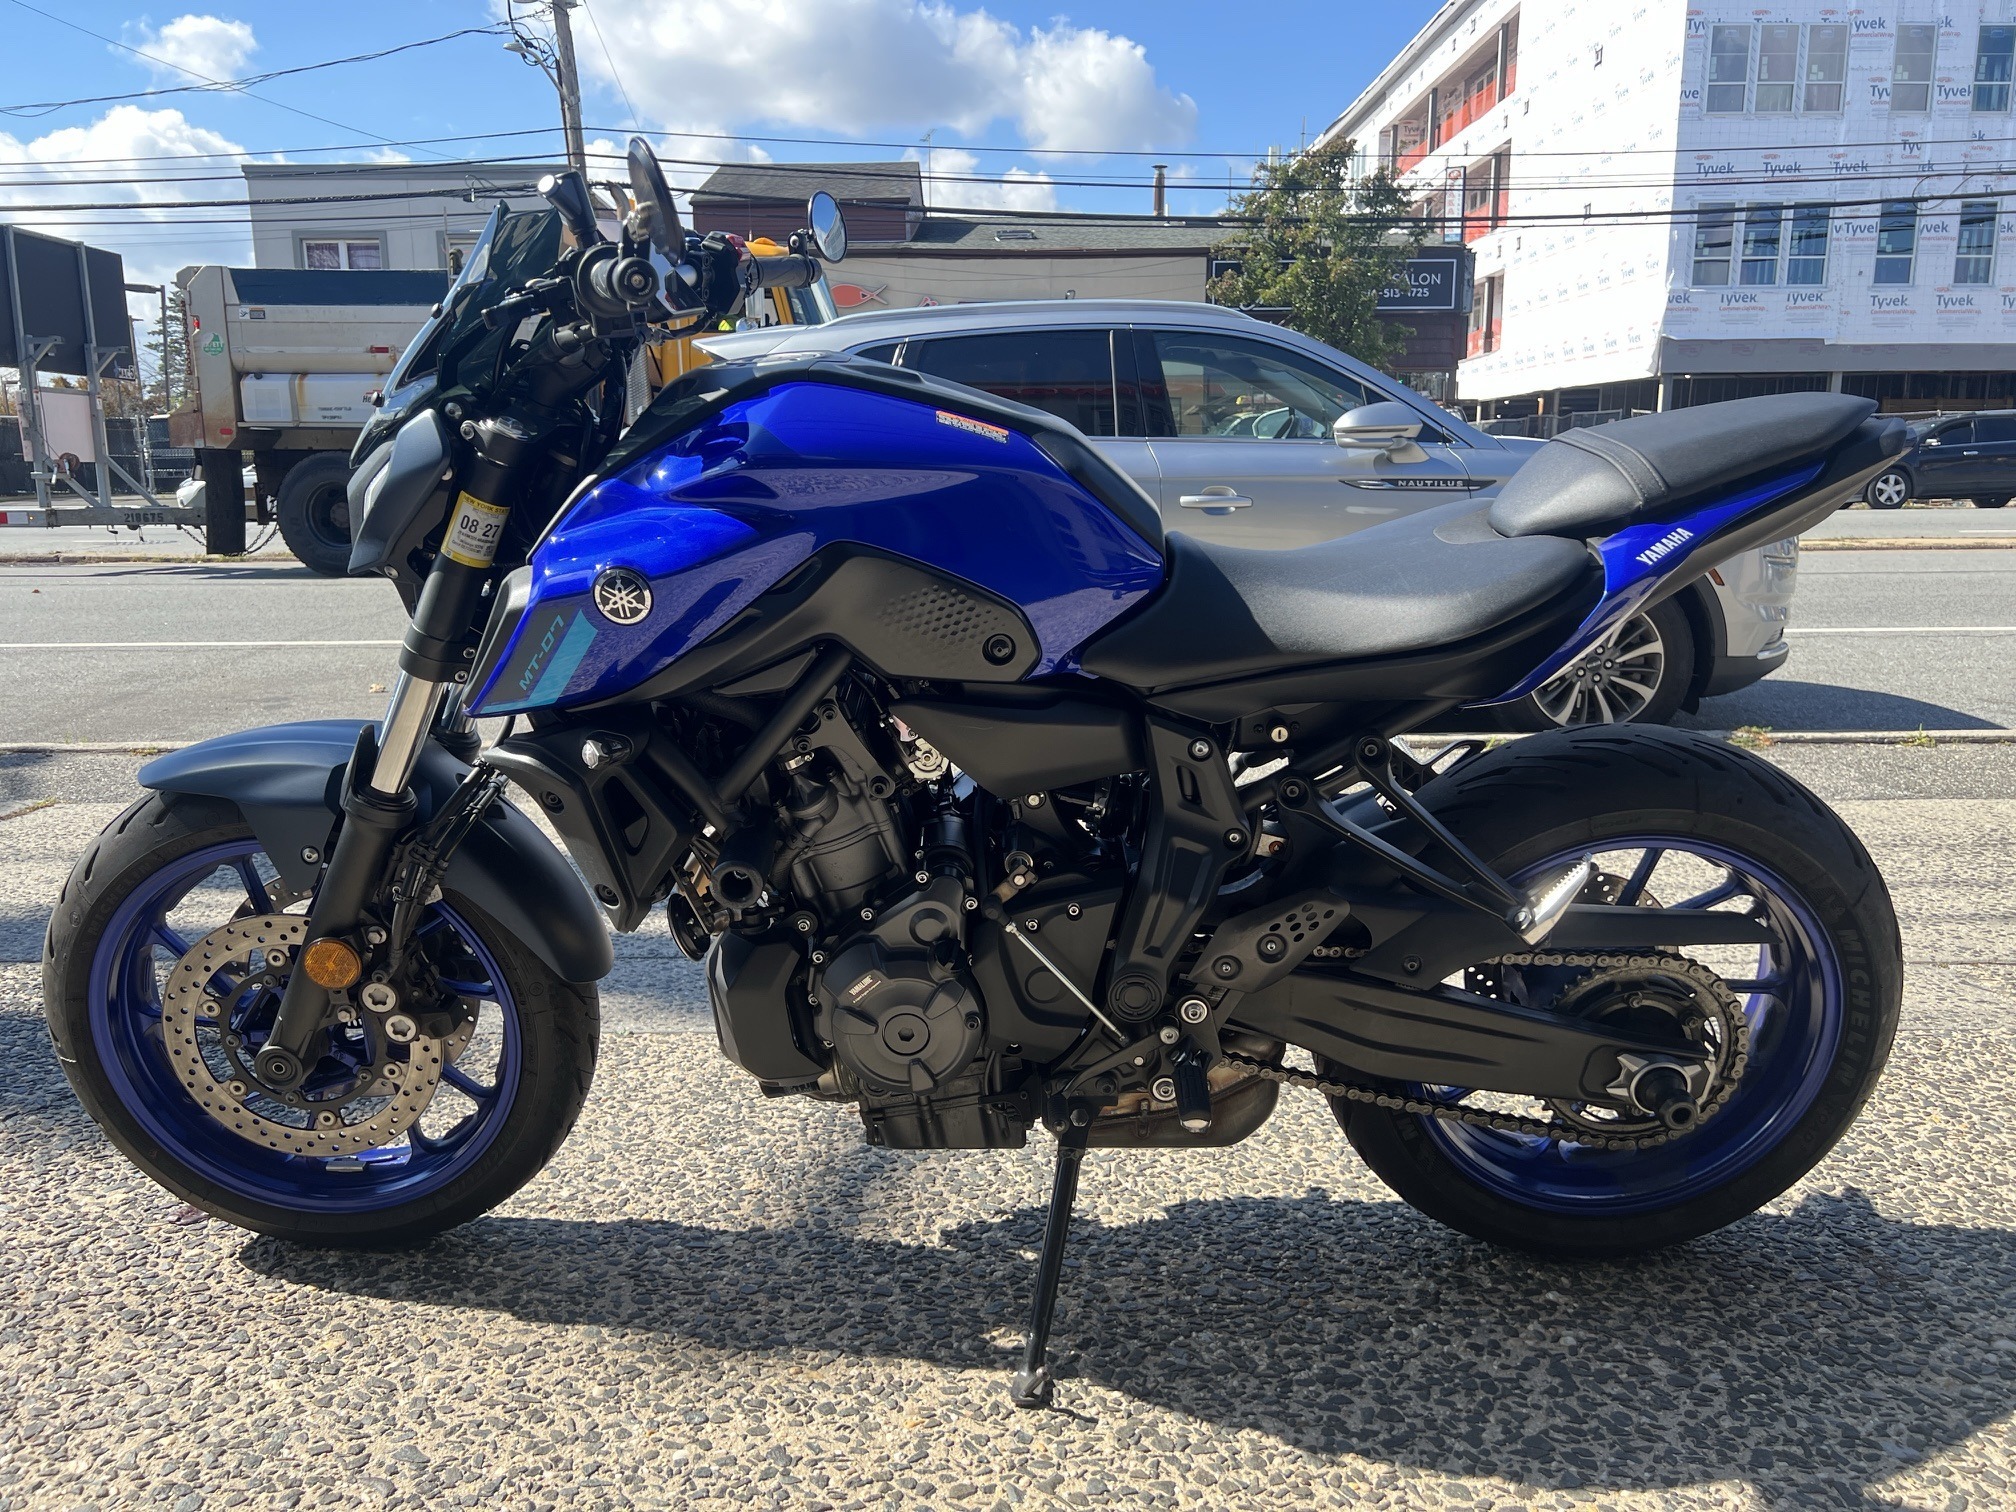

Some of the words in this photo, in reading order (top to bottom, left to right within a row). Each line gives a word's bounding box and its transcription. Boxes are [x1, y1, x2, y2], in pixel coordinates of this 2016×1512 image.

[1853, 16, 1886, 32] yvek
[1696, 162, 1735, 177] Tyvek
[1762, 161, 1802, 177] Tyvek
[1668, 292, 1691, 304] vek
[1870, 294, 1909, 310] Tyvek
[1936, 294, 1974, 309] Tyvek
[362, 395, 372, 403] He
[1397, 480, 1464, 488] NAUTILUS
[477, 501, 493, 511] YORK
[124, 512, 164, 523] 218675
[1635, 527, 1694, 566] YAMAHA
[518, 614, 566, 691] MT-07
[1836, 929, 1872, 1088] MICHELIN
